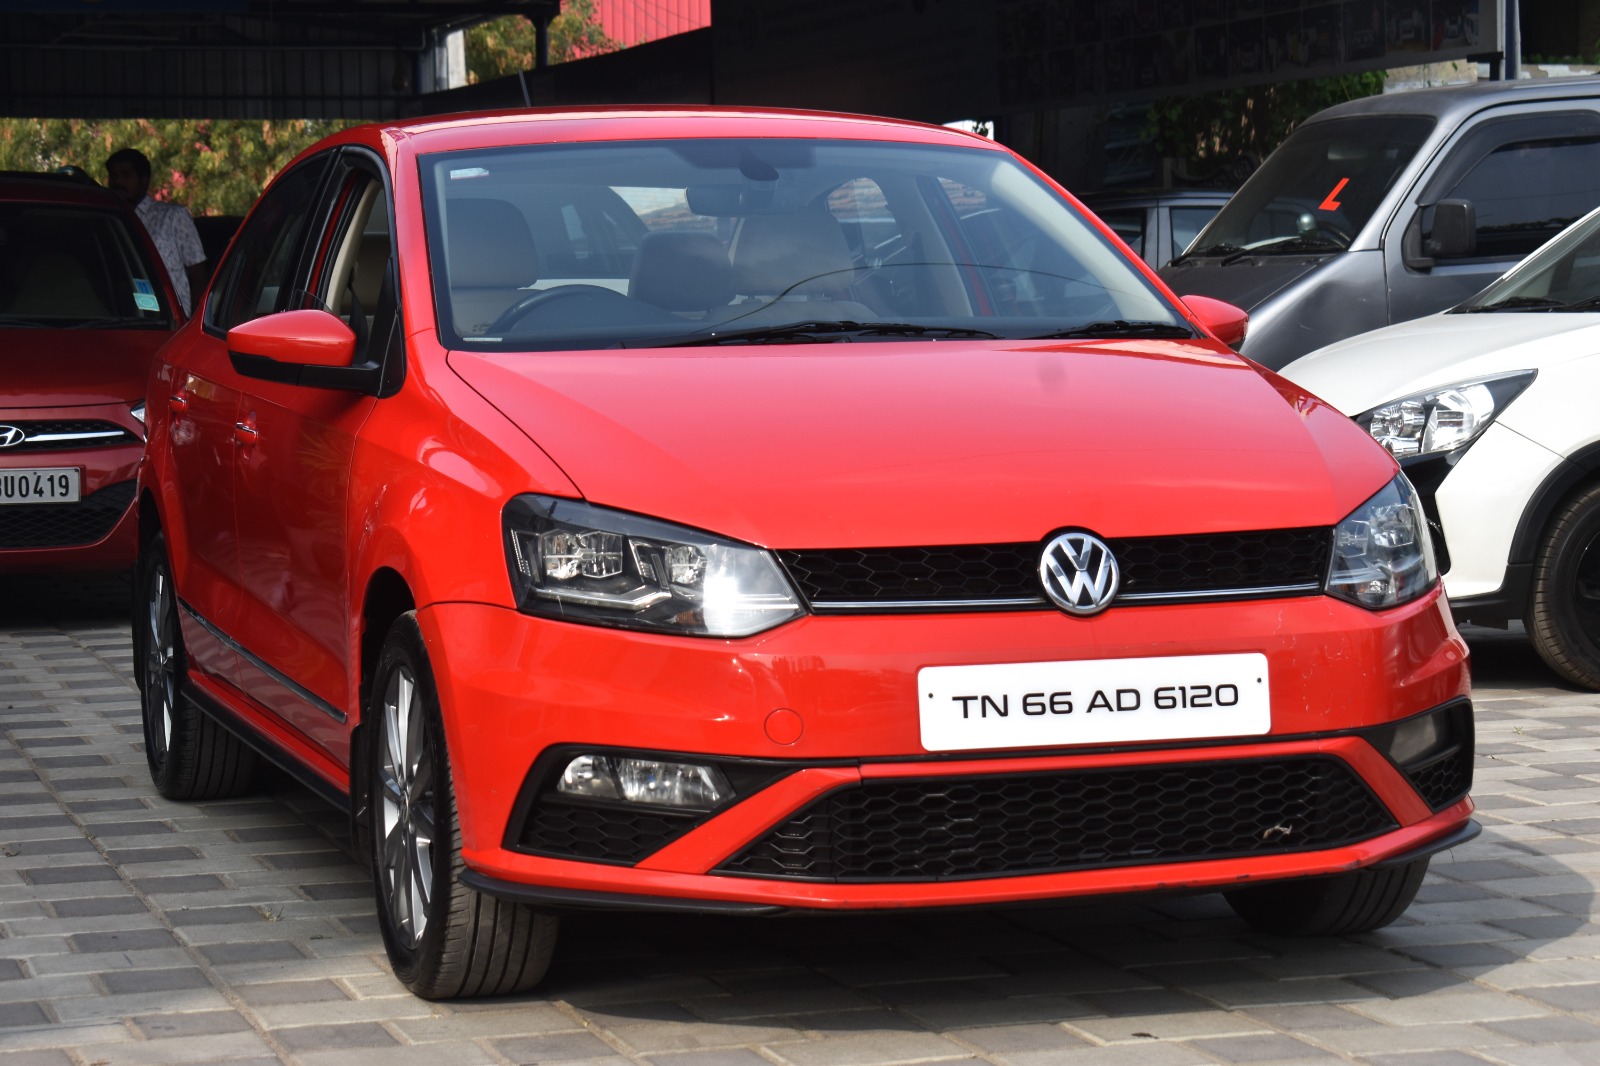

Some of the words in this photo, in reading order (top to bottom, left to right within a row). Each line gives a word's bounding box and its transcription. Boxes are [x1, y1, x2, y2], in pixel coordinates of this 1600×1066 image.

[0, 474, 70, 498] U0419
[952, 694, 1009, 718] TN
[1022, 692, 1073, 715] 66
[1086, 688, 1141, 713] AD
[1154, 684, 1239, 710] 6120
